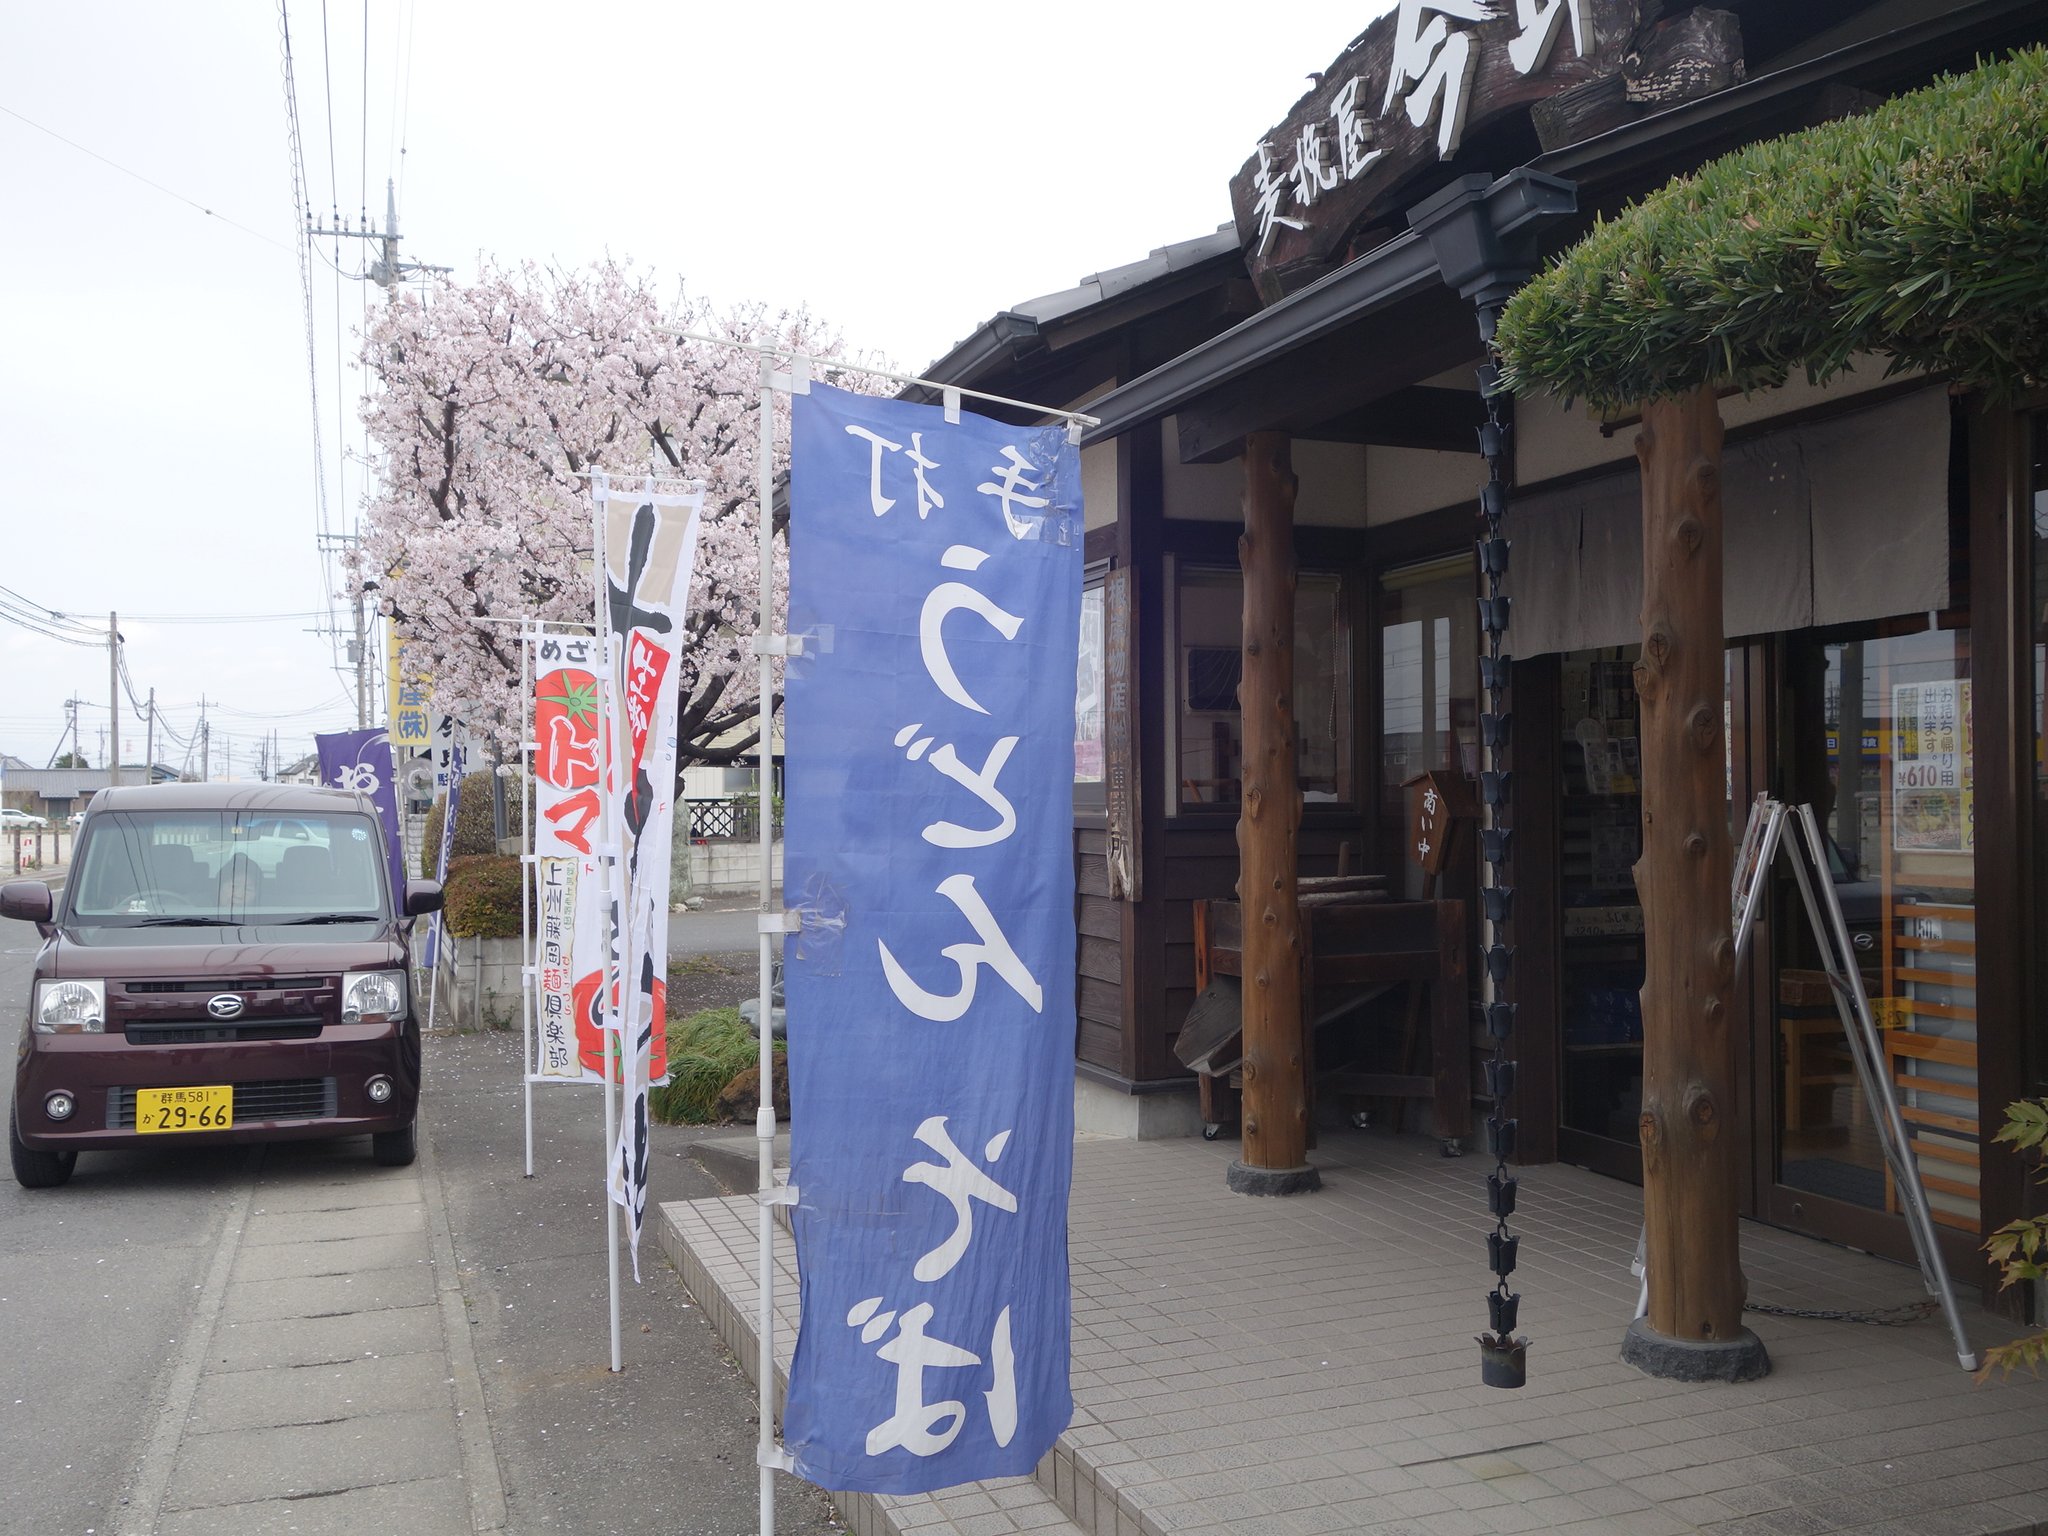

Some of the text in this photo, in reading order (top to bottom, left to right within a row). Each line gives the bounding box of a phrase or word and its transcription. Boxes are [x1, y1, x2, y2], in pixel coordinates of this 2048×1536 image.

[1418, 788, 1438, 861] 商い中
[159, 1105, 227, 1129] 29-66
